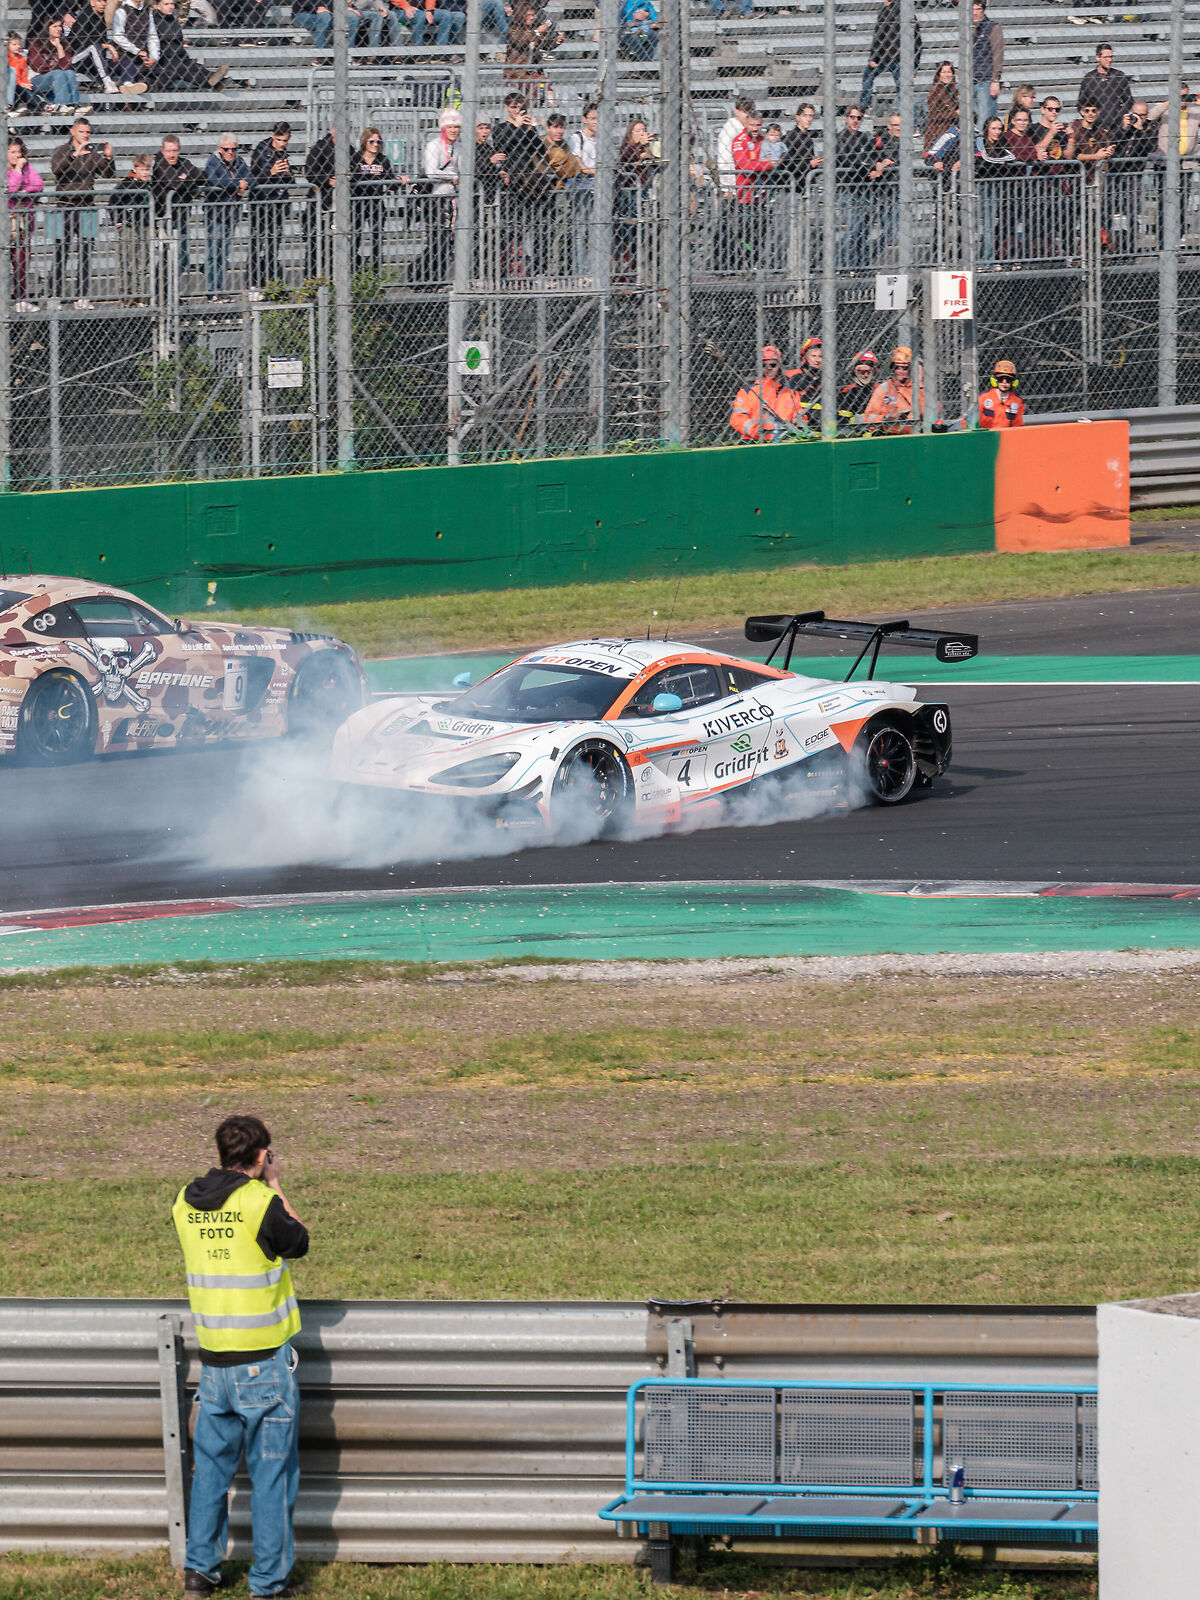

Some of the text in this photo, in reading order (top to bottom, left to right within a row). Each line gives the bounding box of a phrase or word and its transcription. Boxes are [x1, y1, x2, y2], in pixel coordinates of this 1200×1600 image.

[888, 290, 895, 308] 1
[9, 645, 60, 657] Roger Dean
[137, 671, 213, 688] BARTONE
[235, 675, 243, 703] 9
[2, 705, 19, 716] RACE
[1, 716, 18, 728] TAXI
[452, 720, 495, 736] GridFit
[702, 704, 774, 738] KIVERCO
[805, 727, 830, 747] EDGE
[714, 746, 769, 779] GridFit
[677, 759, 691, 787] 4
[200, 1228, 234, 1239] FOTO
[207, 1248, 230, 1260] 1478
